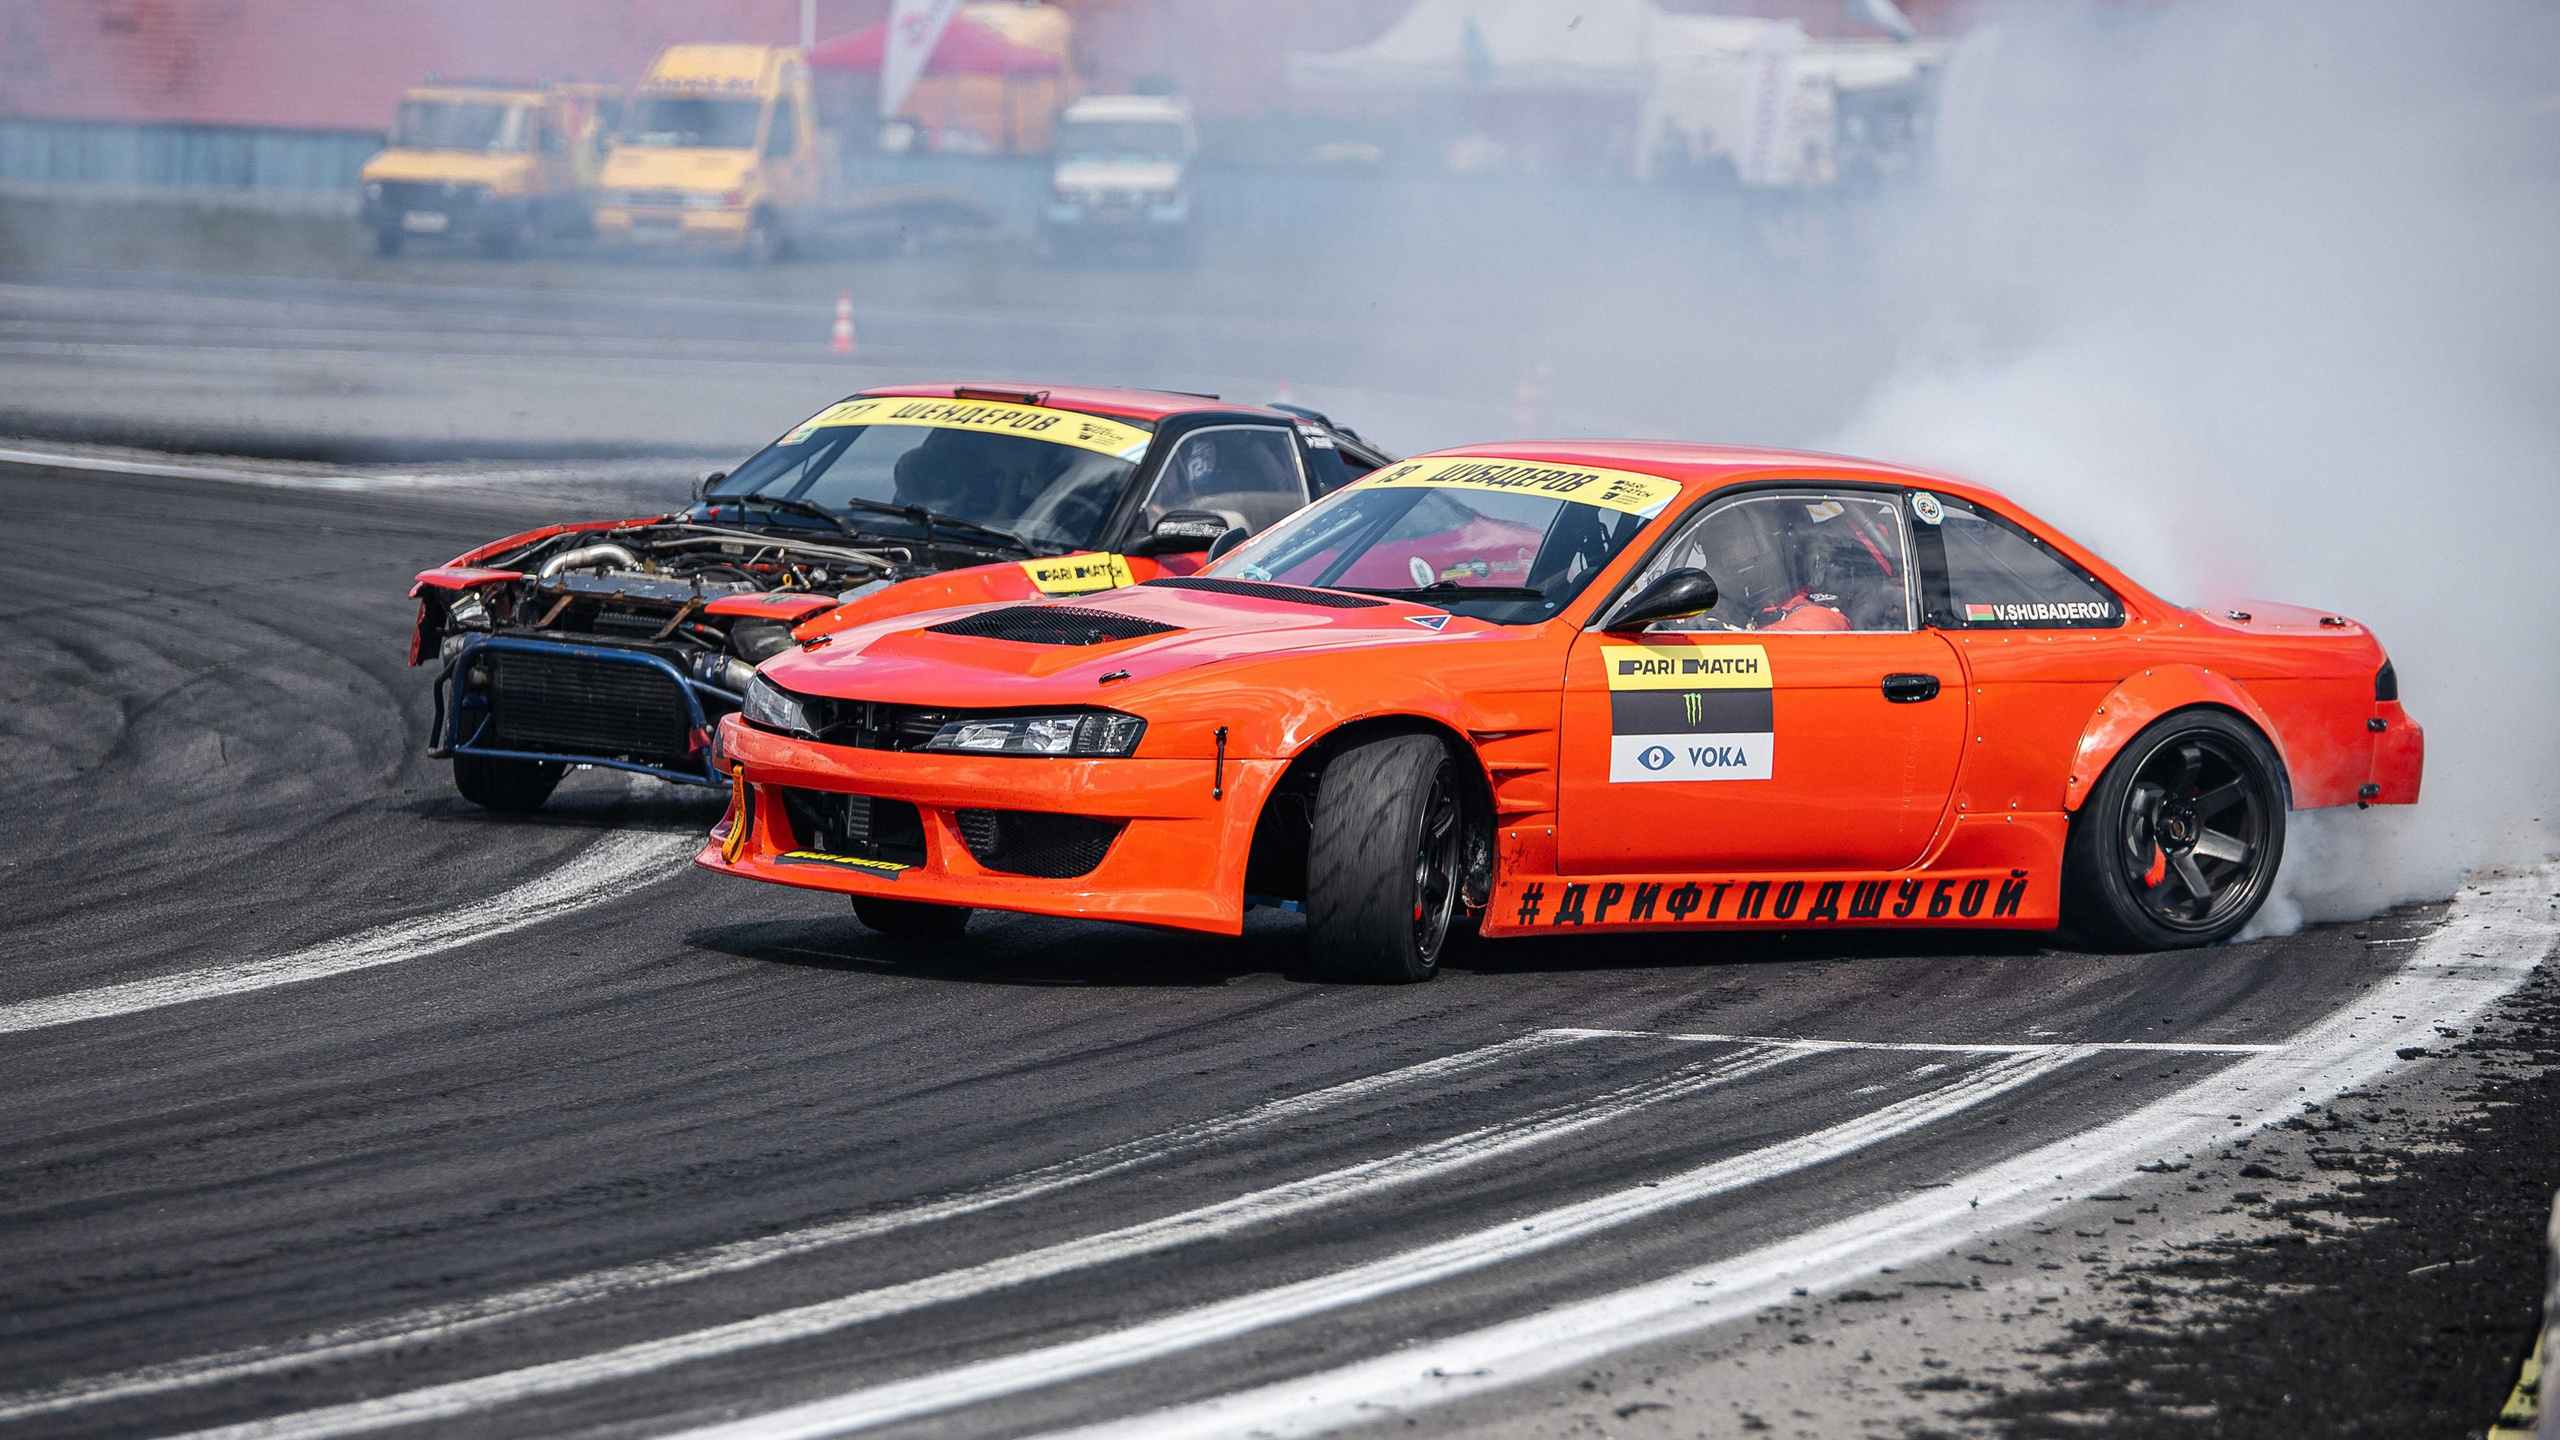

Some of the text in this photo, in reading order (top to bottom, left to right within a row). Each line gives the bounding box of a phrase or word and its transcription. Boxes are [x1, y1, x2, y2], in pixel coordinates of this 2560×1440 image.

[890, 403, 1061, 431] ШЕНДЕРОВ
[1426, 464, 1600, 492] ШУБАДЕРОВ
[1037, 562, 1125, 581] PARI MATCH
[1993, 601, 2110, 622] V.SHUBADEROV
[1619, 658, 1758, 675] PARI MATCH
[1688, 746, 1748, 768] VOKA
[1517, 870, 2029, 926] #ДРИФТПОДШУБОЙ
